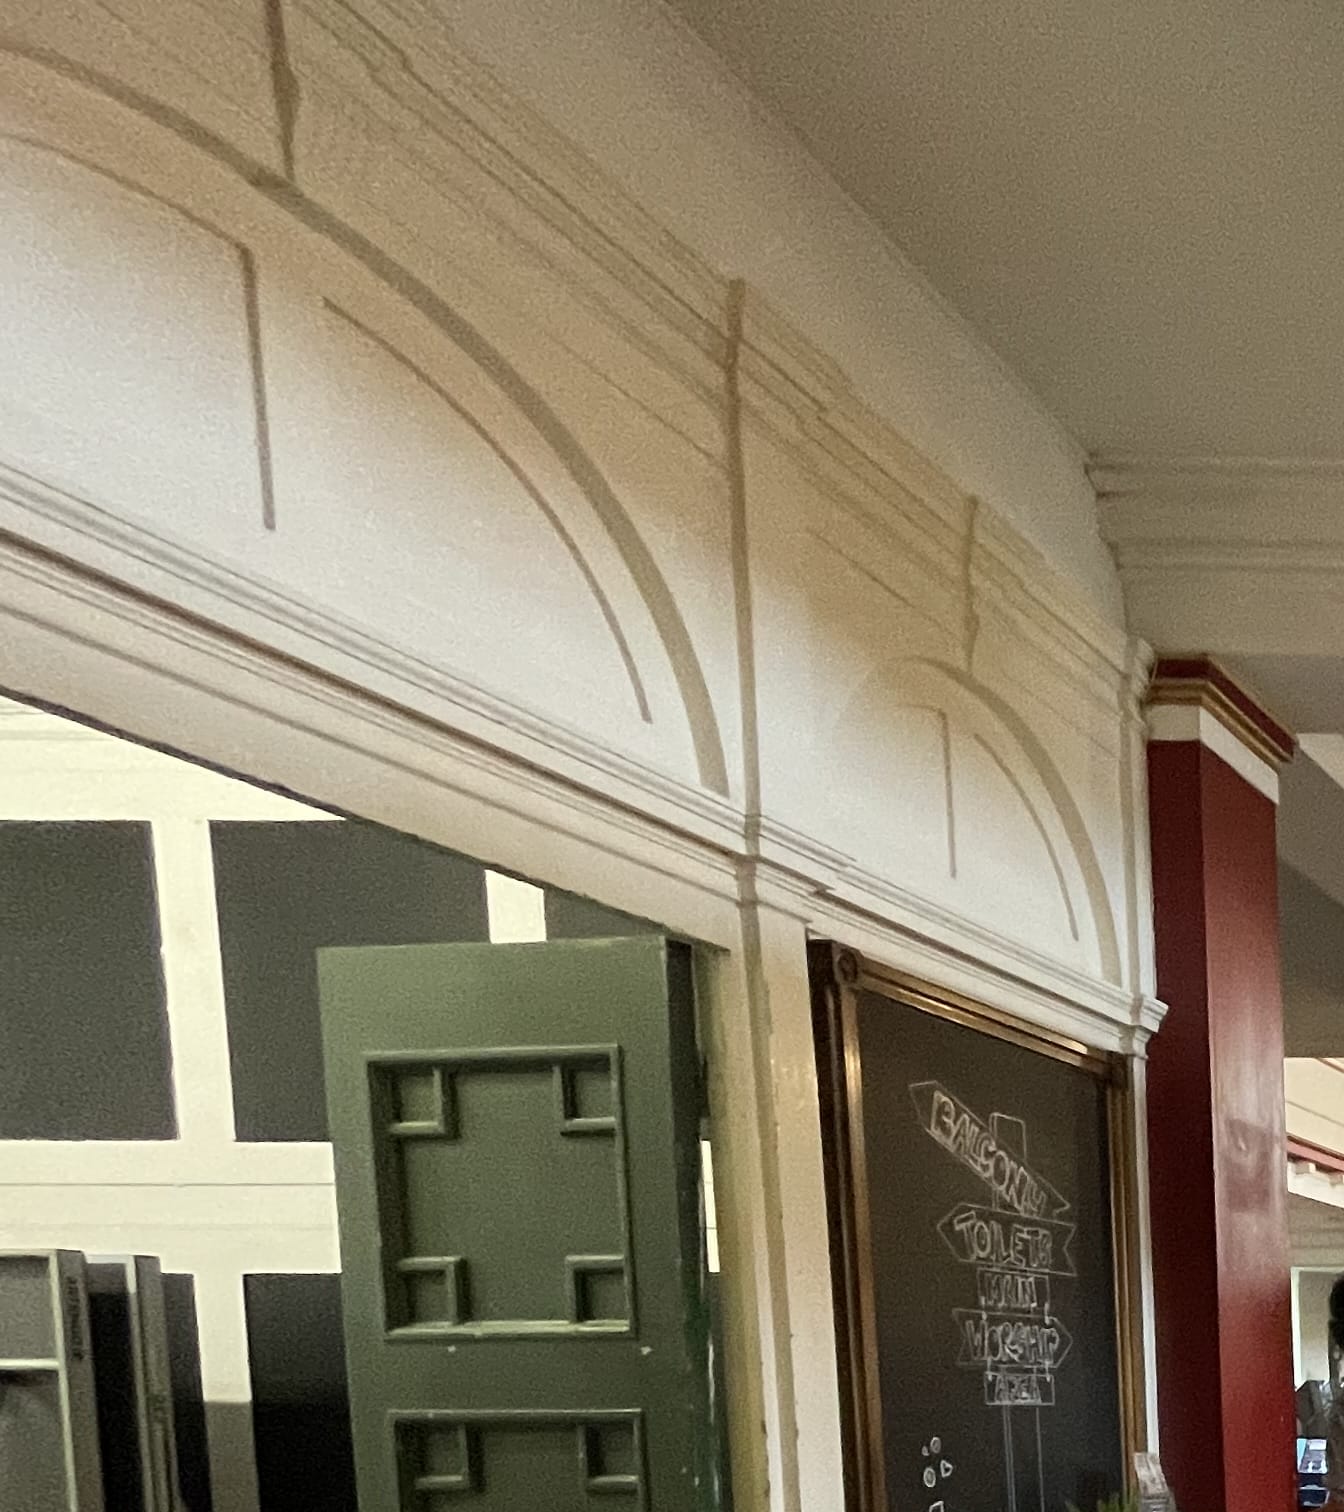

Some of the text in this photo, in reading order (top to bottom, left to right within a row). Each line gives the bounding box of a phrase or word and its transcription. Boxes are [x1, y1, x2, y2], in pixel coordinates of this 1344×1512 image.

[930, 1090, 1047, 1217] BALCONY
[953, 1210, 1053, 1268] TOILETS
[965, 1319, 1060, 1362] WORSHIP
